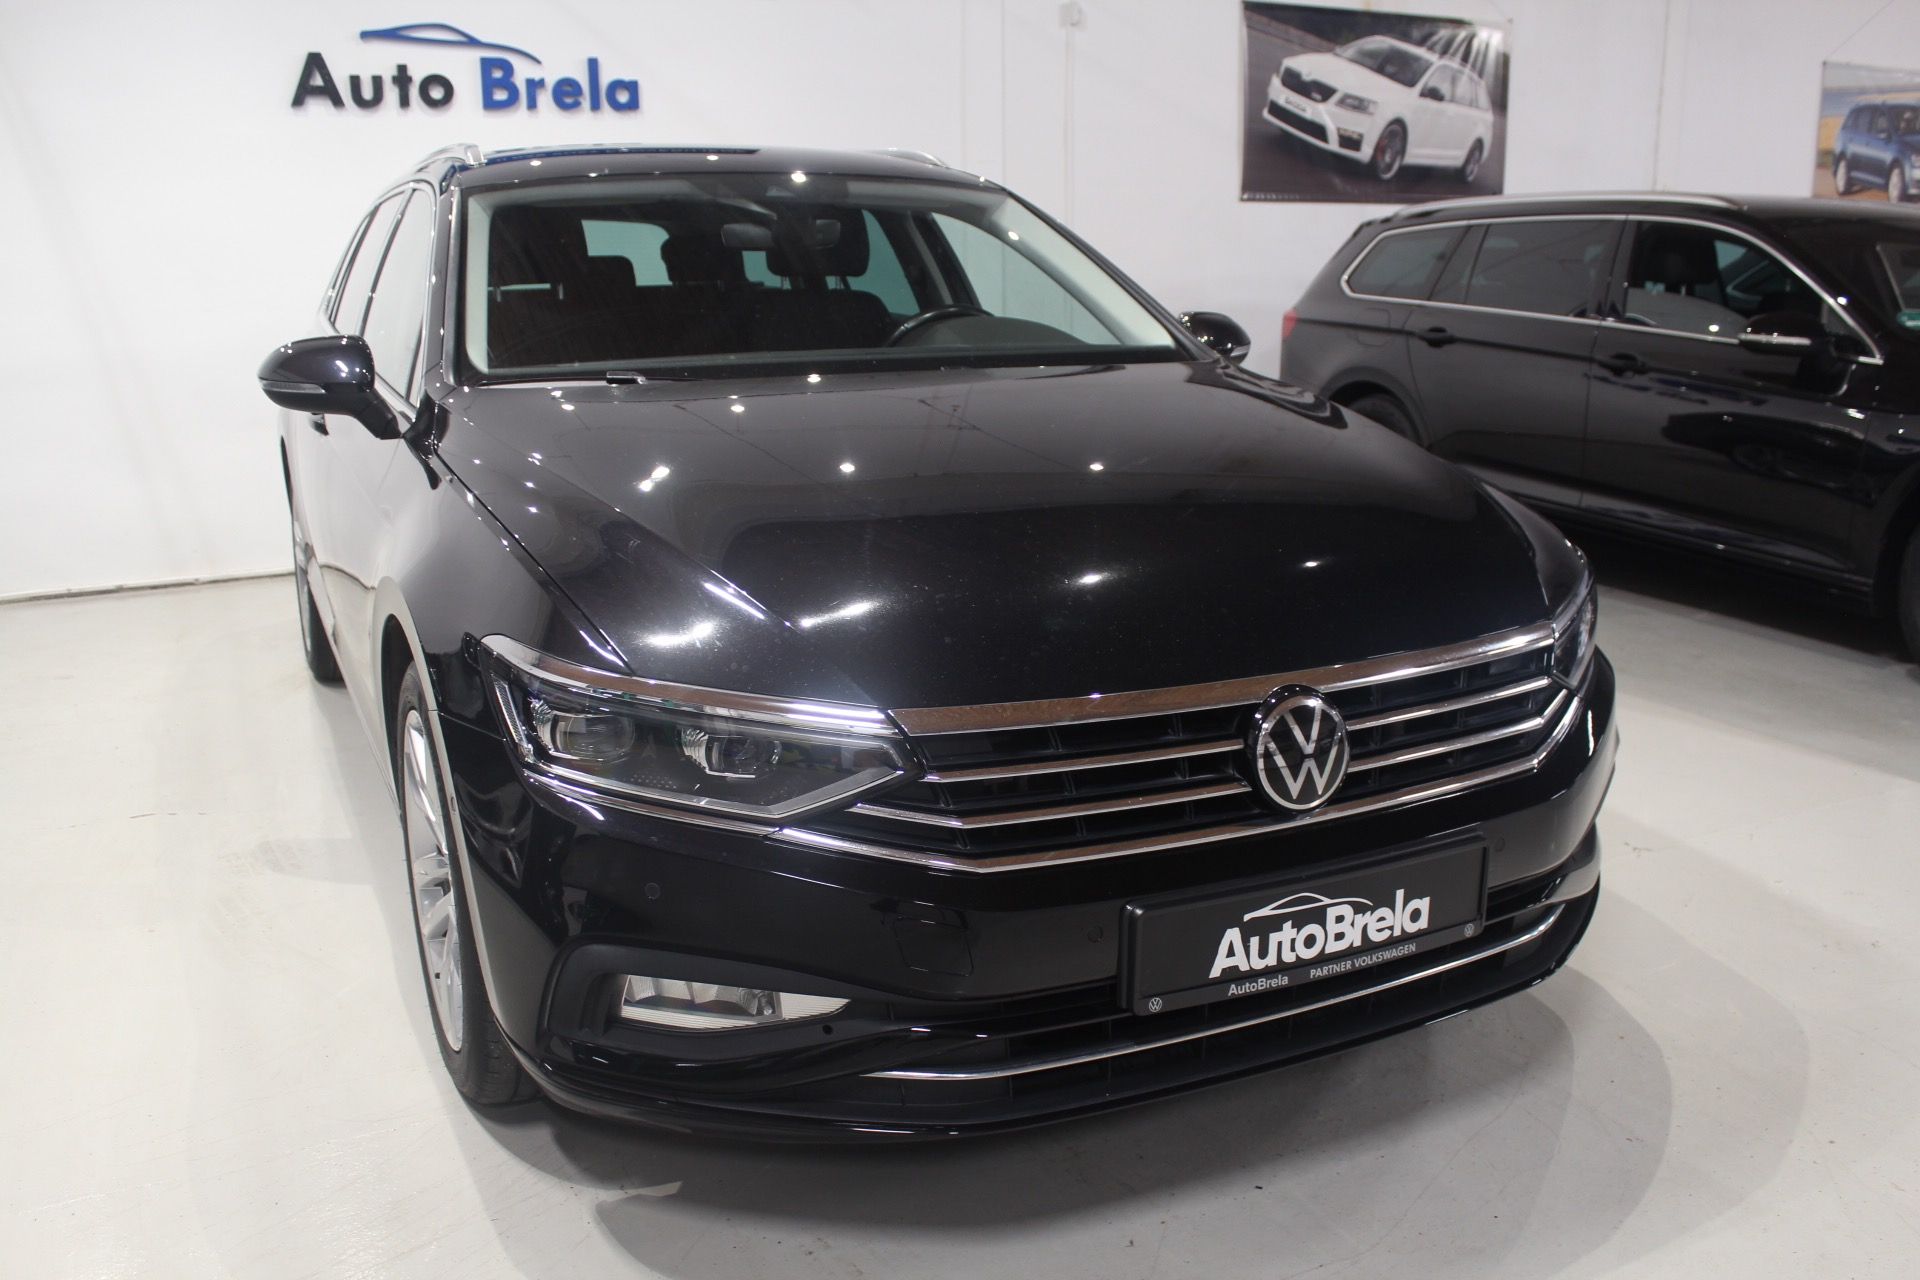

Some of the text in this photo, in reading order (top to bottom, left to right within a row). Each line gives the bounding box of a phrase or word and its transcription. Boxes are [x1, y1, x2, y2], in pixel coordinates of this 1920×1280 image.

[291, 52, 640, 111] Auto Brela
[1209, 888, 1431, 979] AutoBrela
[1309, 942, 1416, 979] PARTNER VOLKSWAGEN
[1228, 974, 1289, 997] AutoBrela
